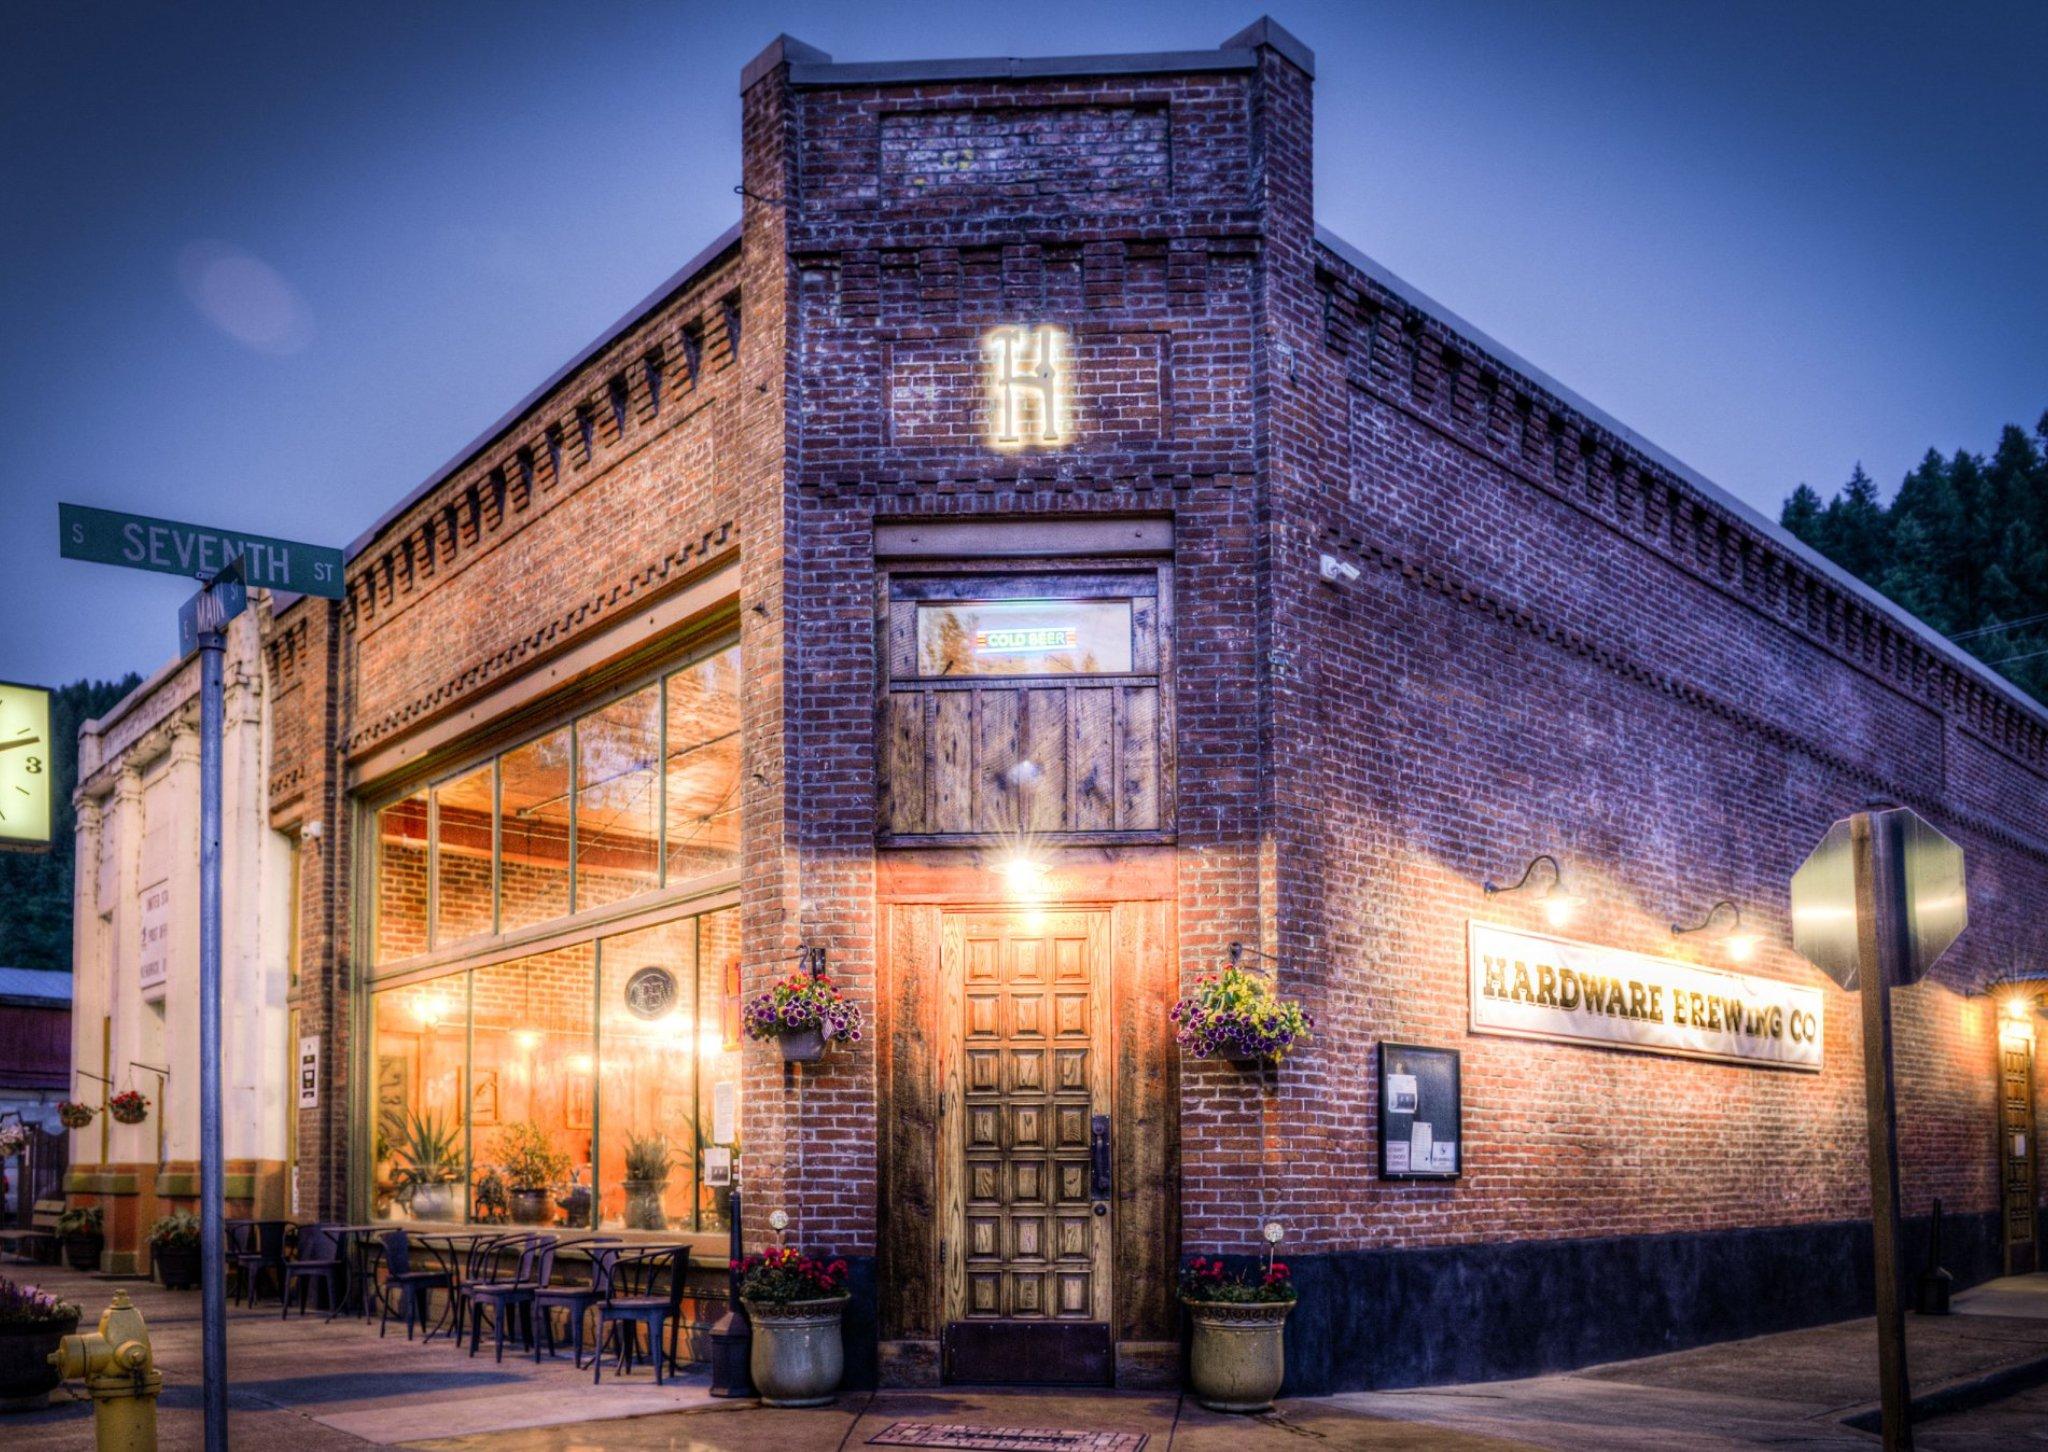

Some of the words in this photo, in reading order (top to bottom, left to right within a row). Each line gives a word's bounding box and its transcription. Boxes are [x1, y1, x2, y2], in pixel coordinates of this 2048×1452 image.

[72, 523, 84, 544] S
[123, 523, 290, 579] SEVENTH
[313, 561, 334, 582] ST
[197, 583, 225, 633] MAIN
[988, 632, 1026, 648] COLD
[1028, 630, 1066, 647] BEER
[25, 756, 42, 774] 3
[1483, 955, 1664, 1025] HARDWARE
[1673, 987, 1783, 1041] BREWING
[1790, 1008, 1816, 1044] CO
